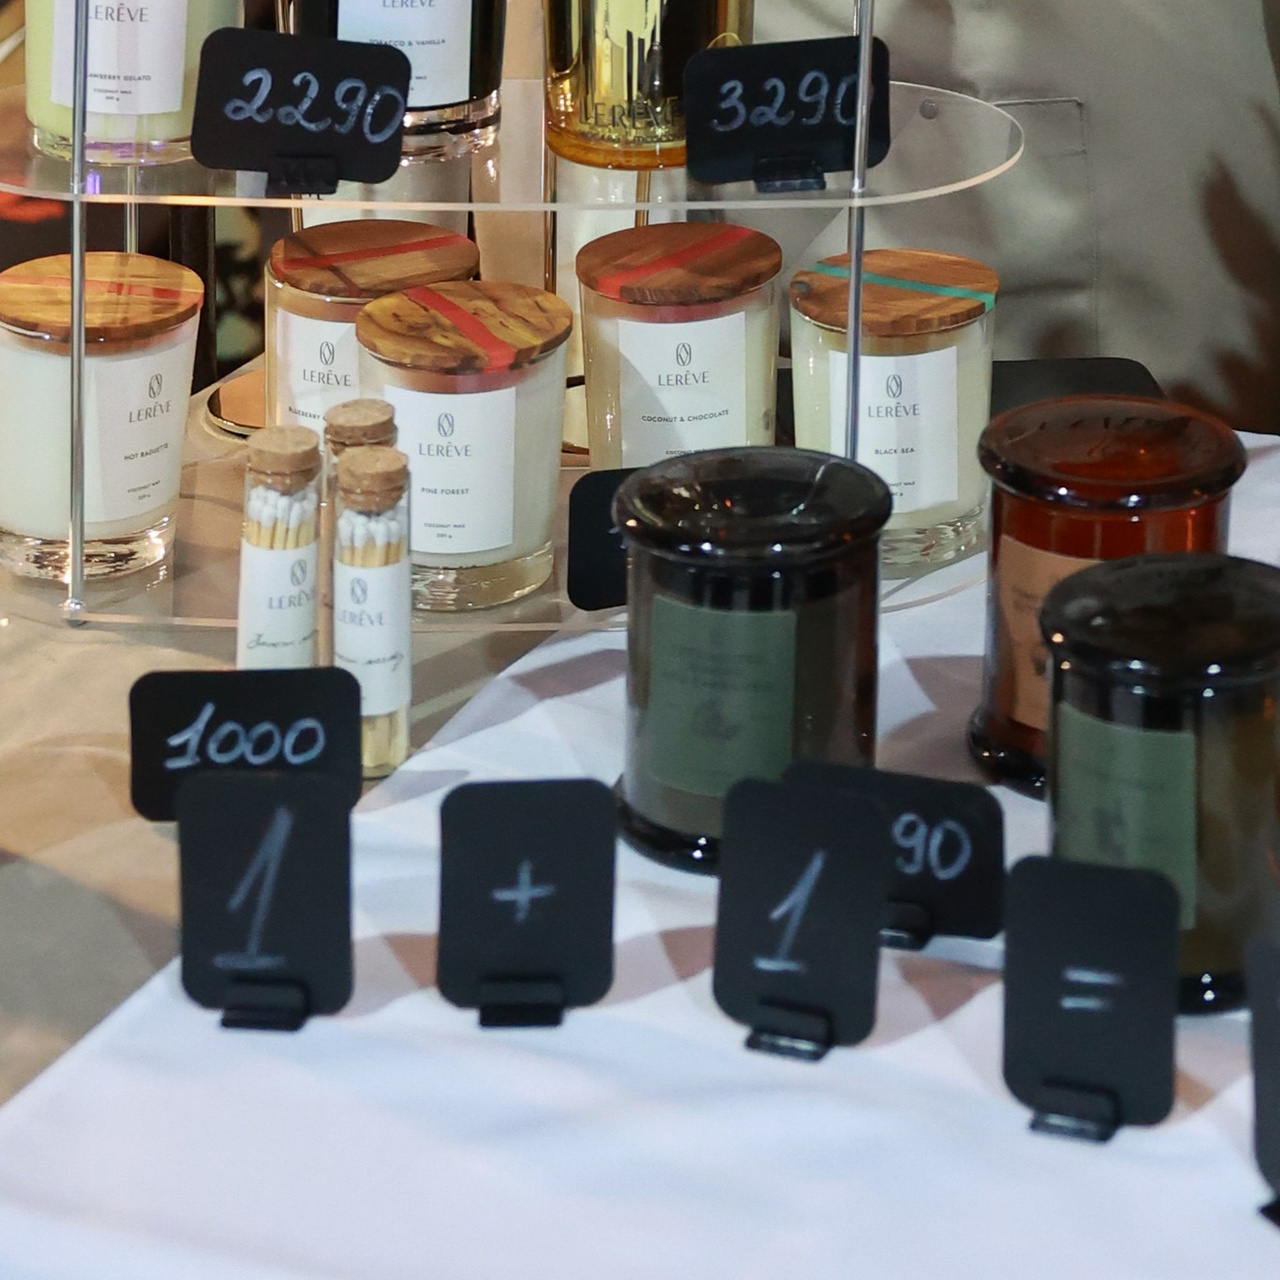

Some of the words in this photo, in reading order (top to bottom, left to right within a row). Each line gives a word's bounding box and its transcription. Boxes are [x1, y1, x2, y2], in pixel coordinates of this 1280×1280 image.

[88, 2, 149, 22] ERÊVE
[224, 67, 406, 145] 2290
[710, 69, 875, 133] 3290
[302, 368, 352, 388] LERÊVE
[657, 369, 710, 387] LERÊVE
[128, 400, 172, 424] LERÊVE
[641, 415, 677, 423] COCONUT
[687, 409, 730, 423] CHOCOLATE
[867, 401, 920, 418] LERÊVE
[418, 441, 472, 458] LERÊVE
[441, 488, 470, 496] FOREST
[163, 701, 326, 770] 1000
[212, 804, 294, 970] 1
[753, 847, 827, 974] 1
